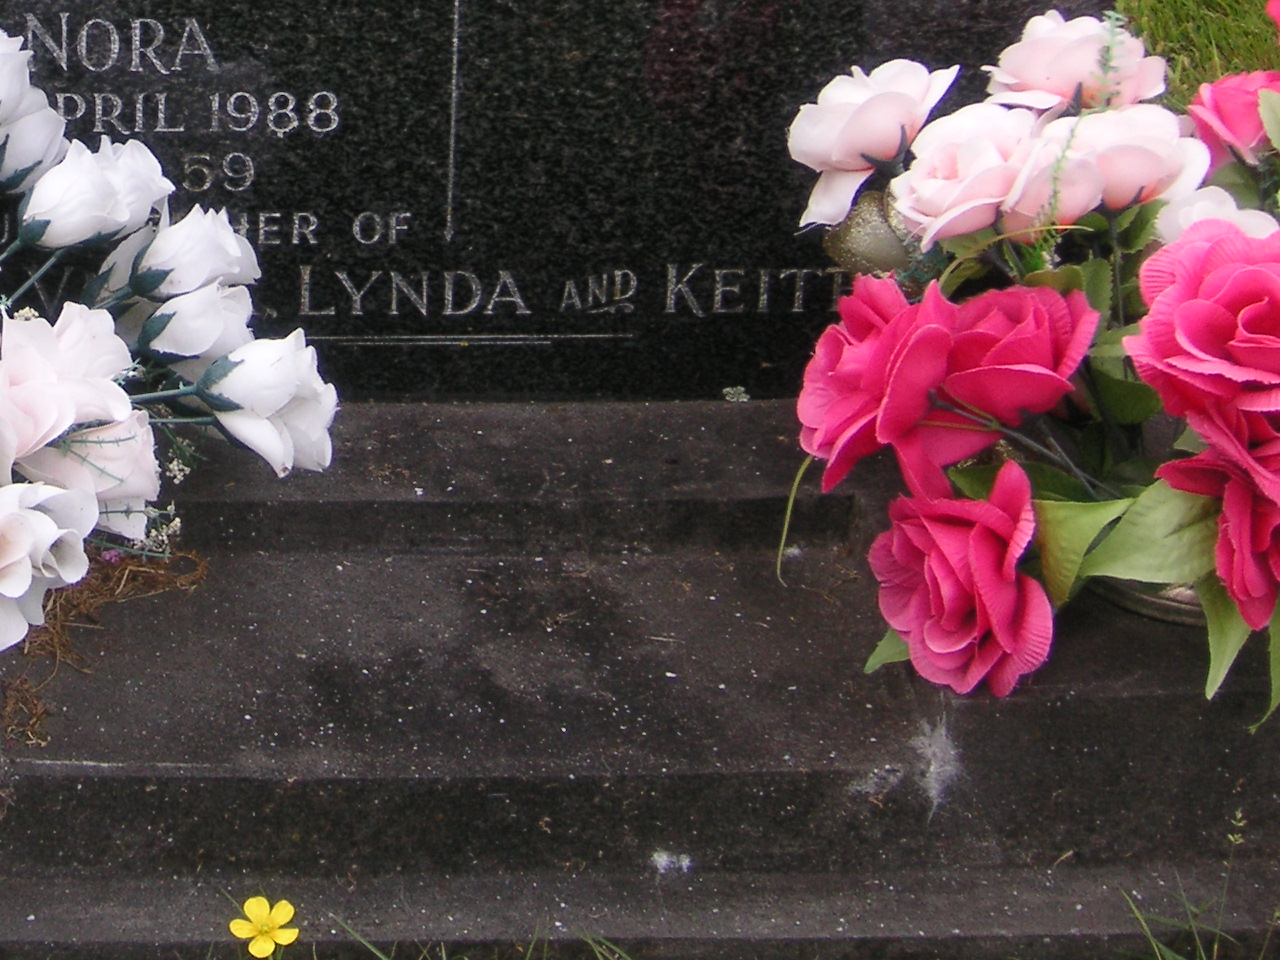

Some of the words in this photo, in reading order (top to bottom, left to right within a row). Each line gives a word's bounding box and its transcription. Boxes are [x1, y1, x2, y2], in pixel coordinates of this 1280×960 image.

[23, 12, 220, 75] NORA
[53, 91, 186, 136] PRIL
[208, 90, 340, 138] 1988
[181, 151, 255, 191] 59
[352, 210, 413, 246] OF
[298, 264, 533, 318] LYNDA
[558, 269, 638, 315] AND
